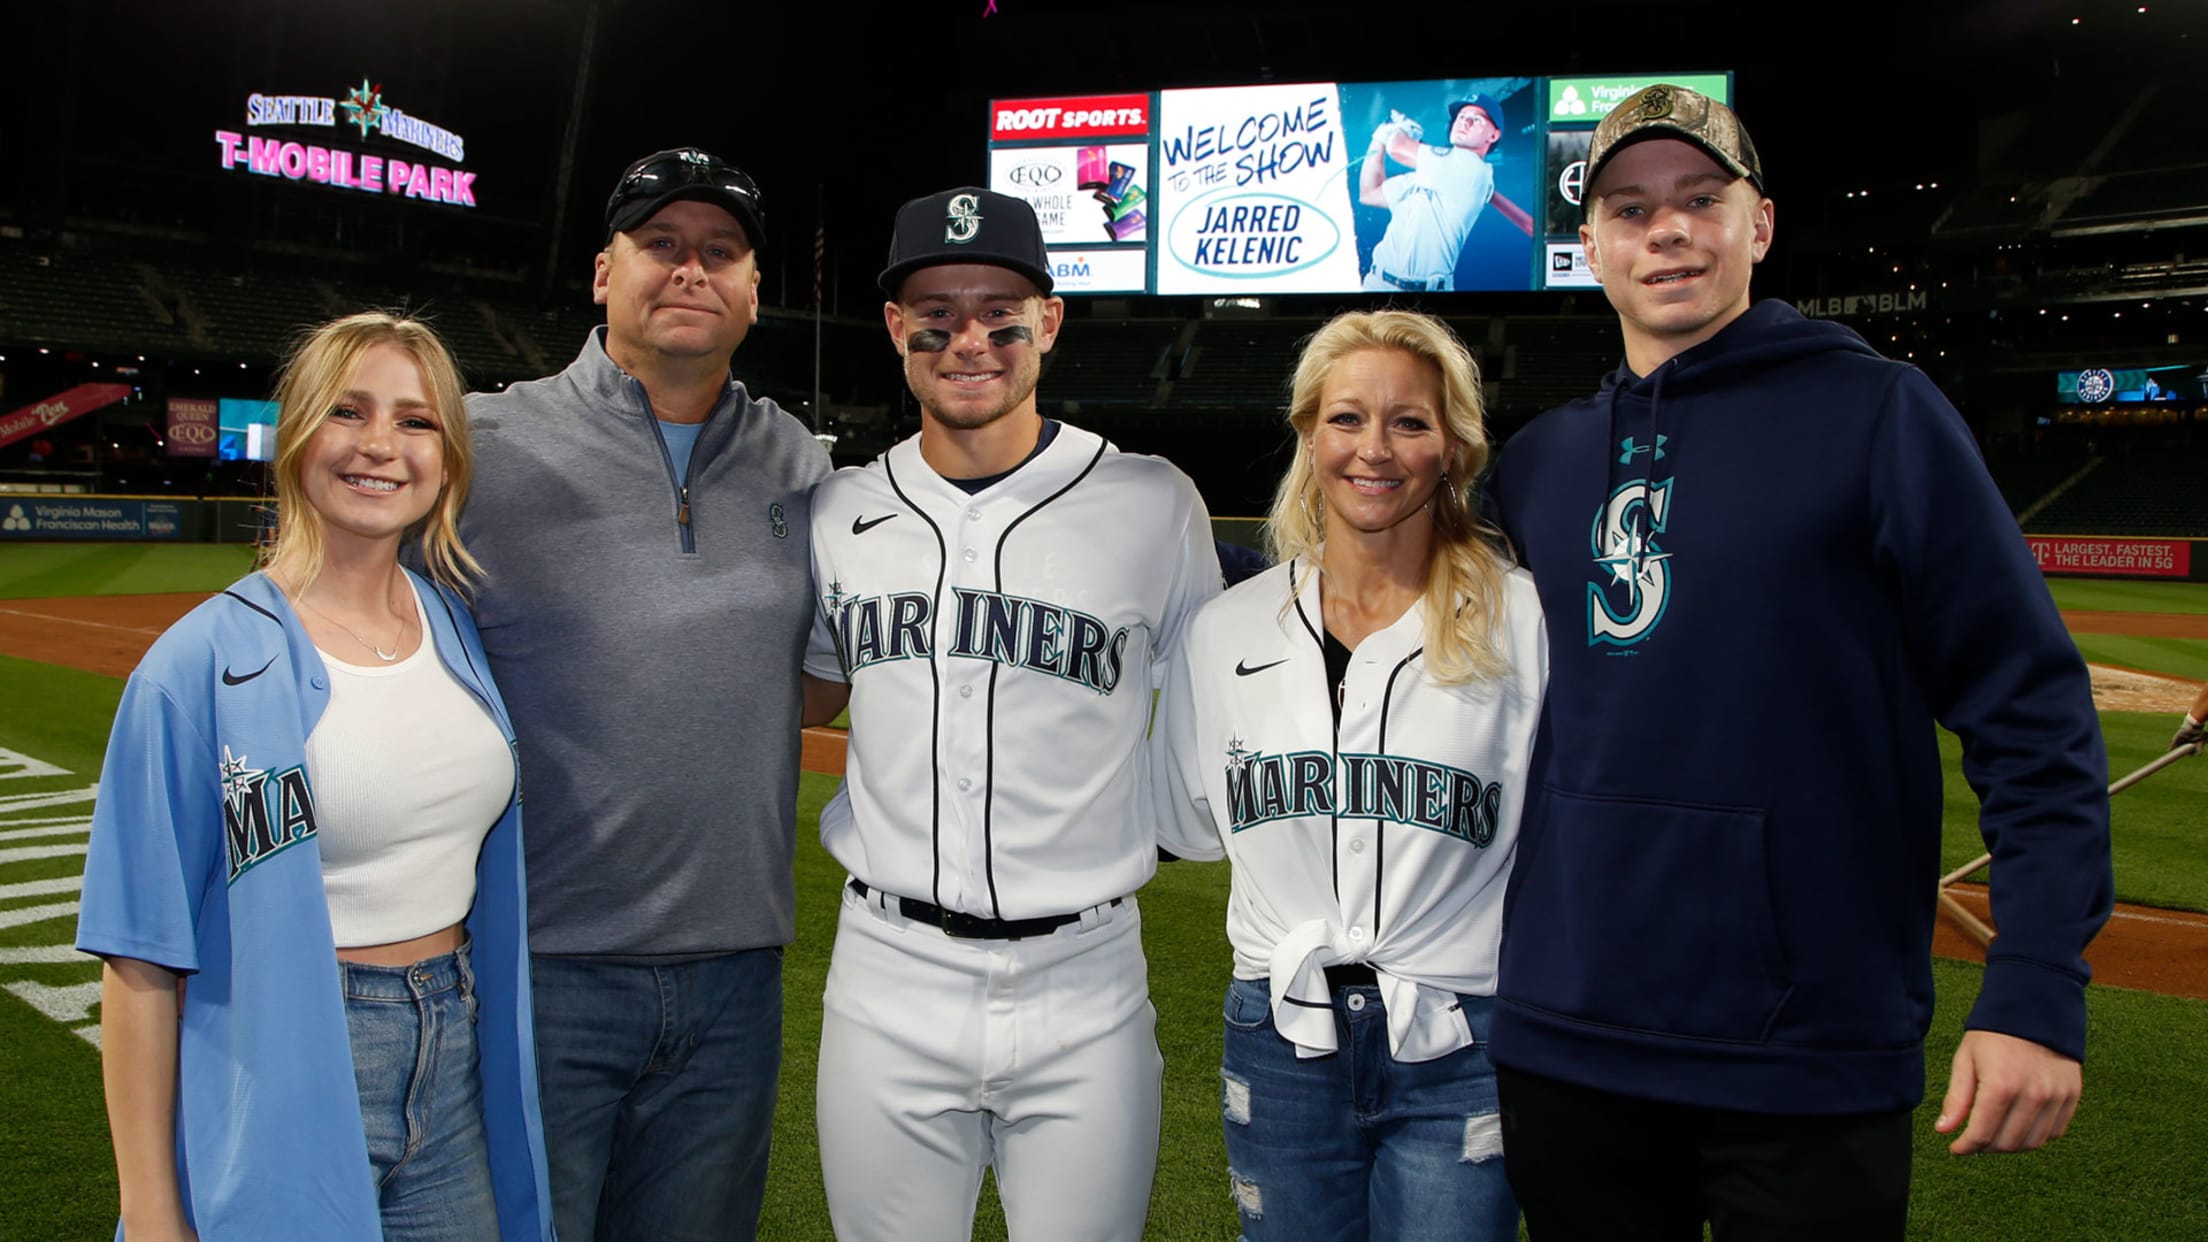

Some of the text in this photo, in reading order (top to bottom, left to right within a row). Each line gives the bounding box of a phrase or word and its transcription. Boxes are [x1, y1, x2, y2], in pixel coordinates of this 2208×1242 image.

[247, 93, 465, 162] SEATTLE MARINERS
[996, 108, 1062, 131] ROOT
[1163, 97, 1327, 166] WELCOME
[215, 130, 477, 207] T-MOBILE PARK
[1193, 162, 1227, 185] THE
[1235, 131, 1334, 186] SHOW
[1033, 195, 1072, 210] WHOLE
[1197, 205, 1301, 234] JARRED
[1194, 236, 1303, 265] KELENIC
[1797, 291, 1926, 317] MLB BLM
[168, 402, 217, 414] EMERALD
[176, 411, 209, 422] QUEEN
[35, 506, 122, 519] Virginia Mason
[35, 519, 99, 530] Franciscan
[101, 520, 139, 531] Health
[2055, 543, 2113, 555] LARGEST.
[2116, 544, 2174, 557] FASTEST.
[2055, 554, 2173, 569] THE LEADER IN 5G
[1225, 749, 1503, 849] MARINERS
